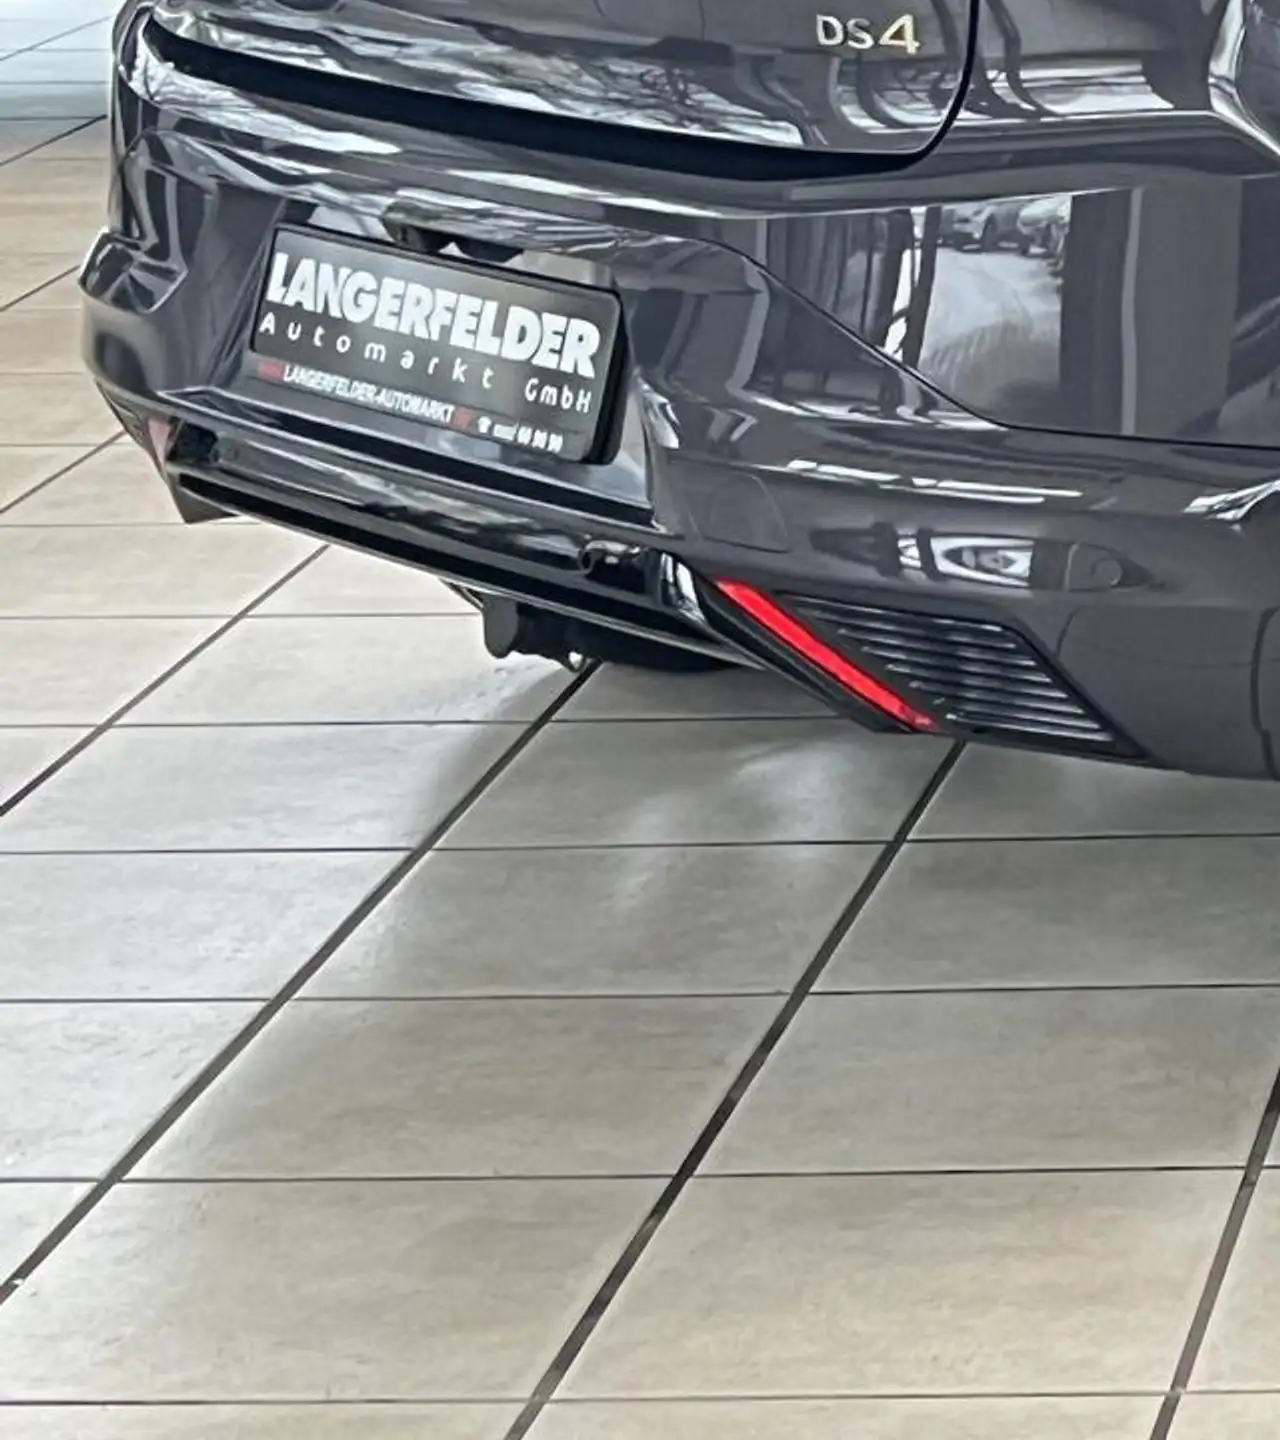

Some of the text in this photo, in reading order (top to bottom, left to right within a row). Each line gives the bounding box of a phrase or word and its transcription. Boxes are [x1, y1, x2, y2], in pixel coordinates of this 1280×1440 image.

[258, 311, 592, 415] Automarkt GmbH
[266, 252, 601, 379] LANGERFELDER
